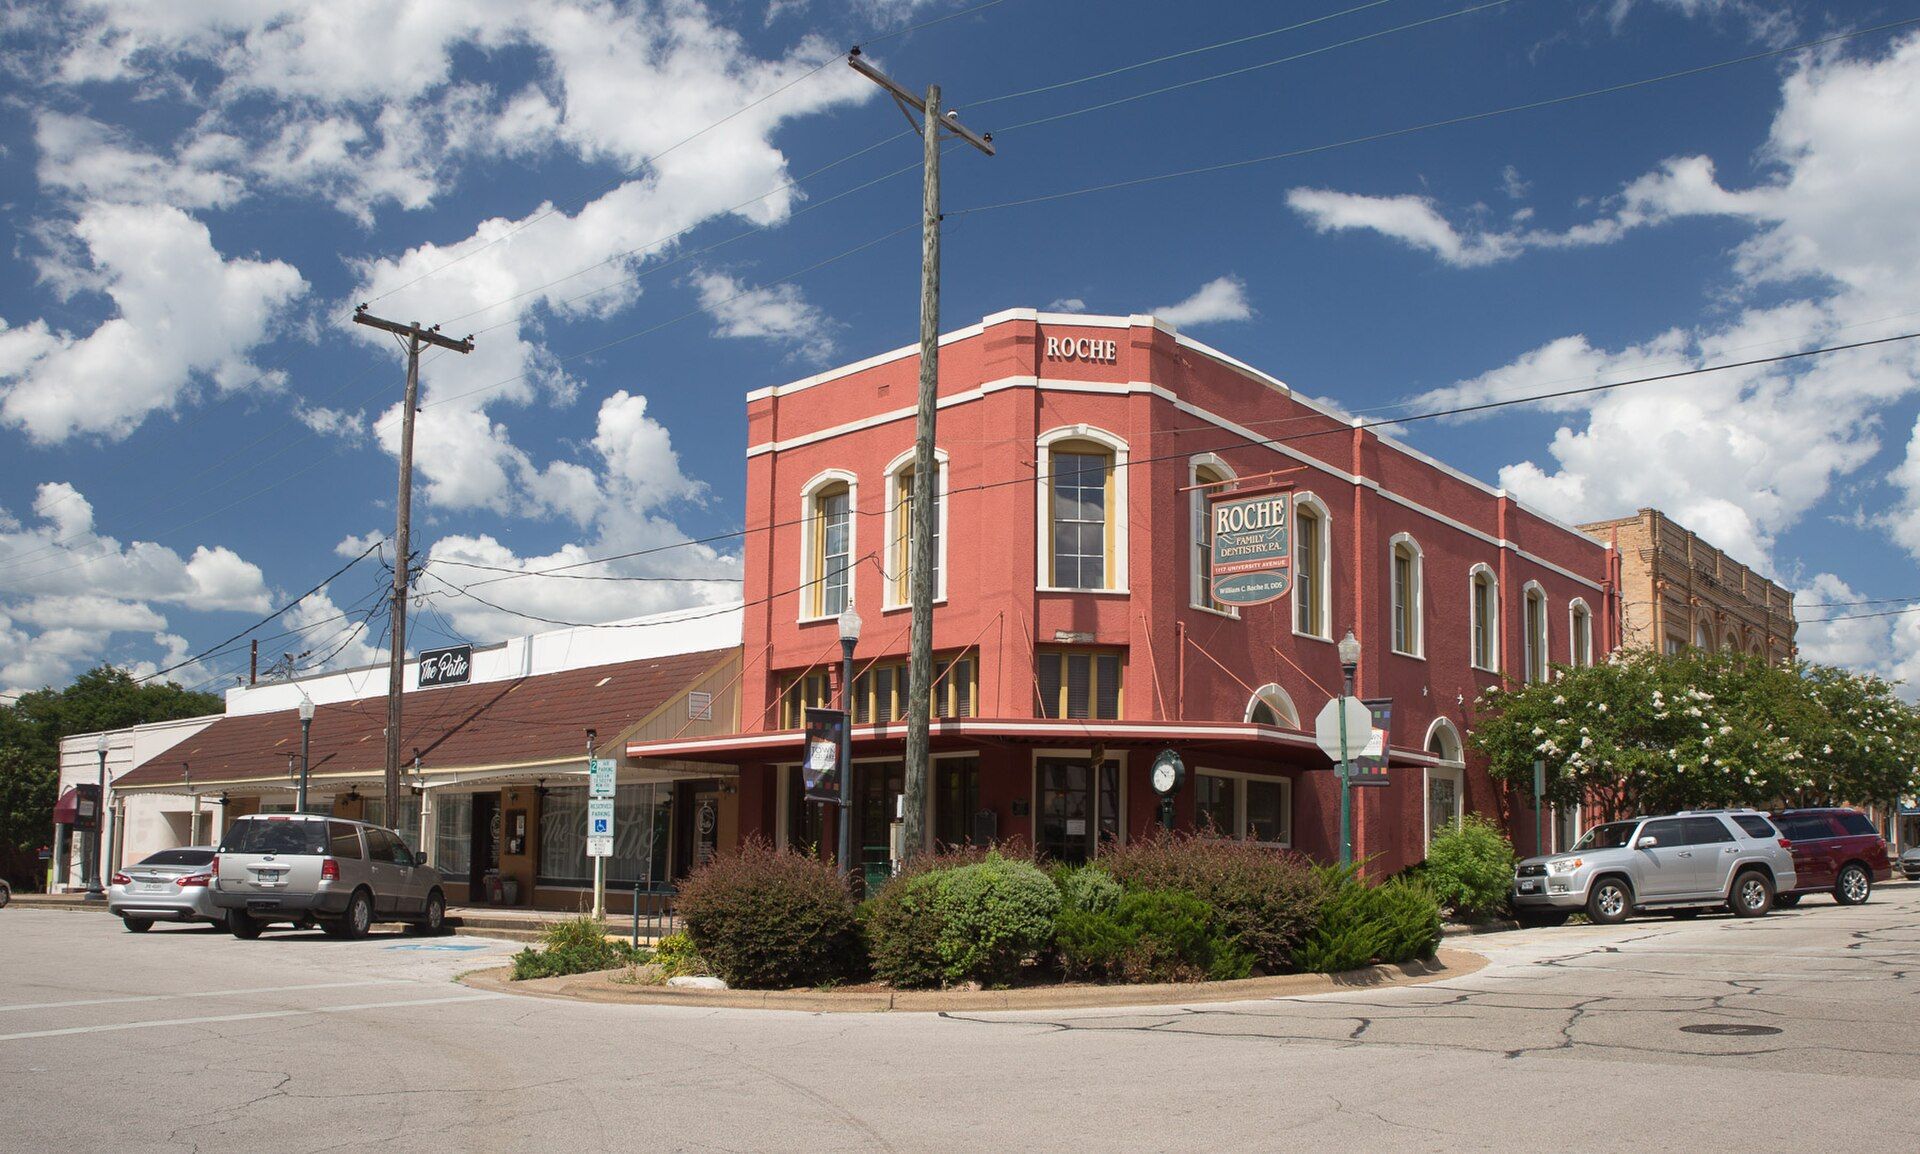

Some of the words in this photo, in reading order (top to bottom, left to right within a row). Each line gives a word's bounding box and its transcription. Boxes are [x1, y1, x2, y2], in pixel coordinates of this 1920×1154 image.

[1047, 336, 1116, 360] ROCHE
[1216, 499, 1285, 535] ROCHE
[1236, 534, 1265, 546] FAMILY
[1227, 563, 1261, 573] UNIVERSITY
[1262, 560, 1286, 569] AVENUE
[1219, 586, 1240, 594] William
[1247, 583, 1264, 592] Roche
[1270, 581, 1283, 589] DDS
[421, 657, 438, 682] The
[438, 652, 469, 681] Patio
[811, 746, 835, 754] TOWN
[591, 761, 597, 770] 2
